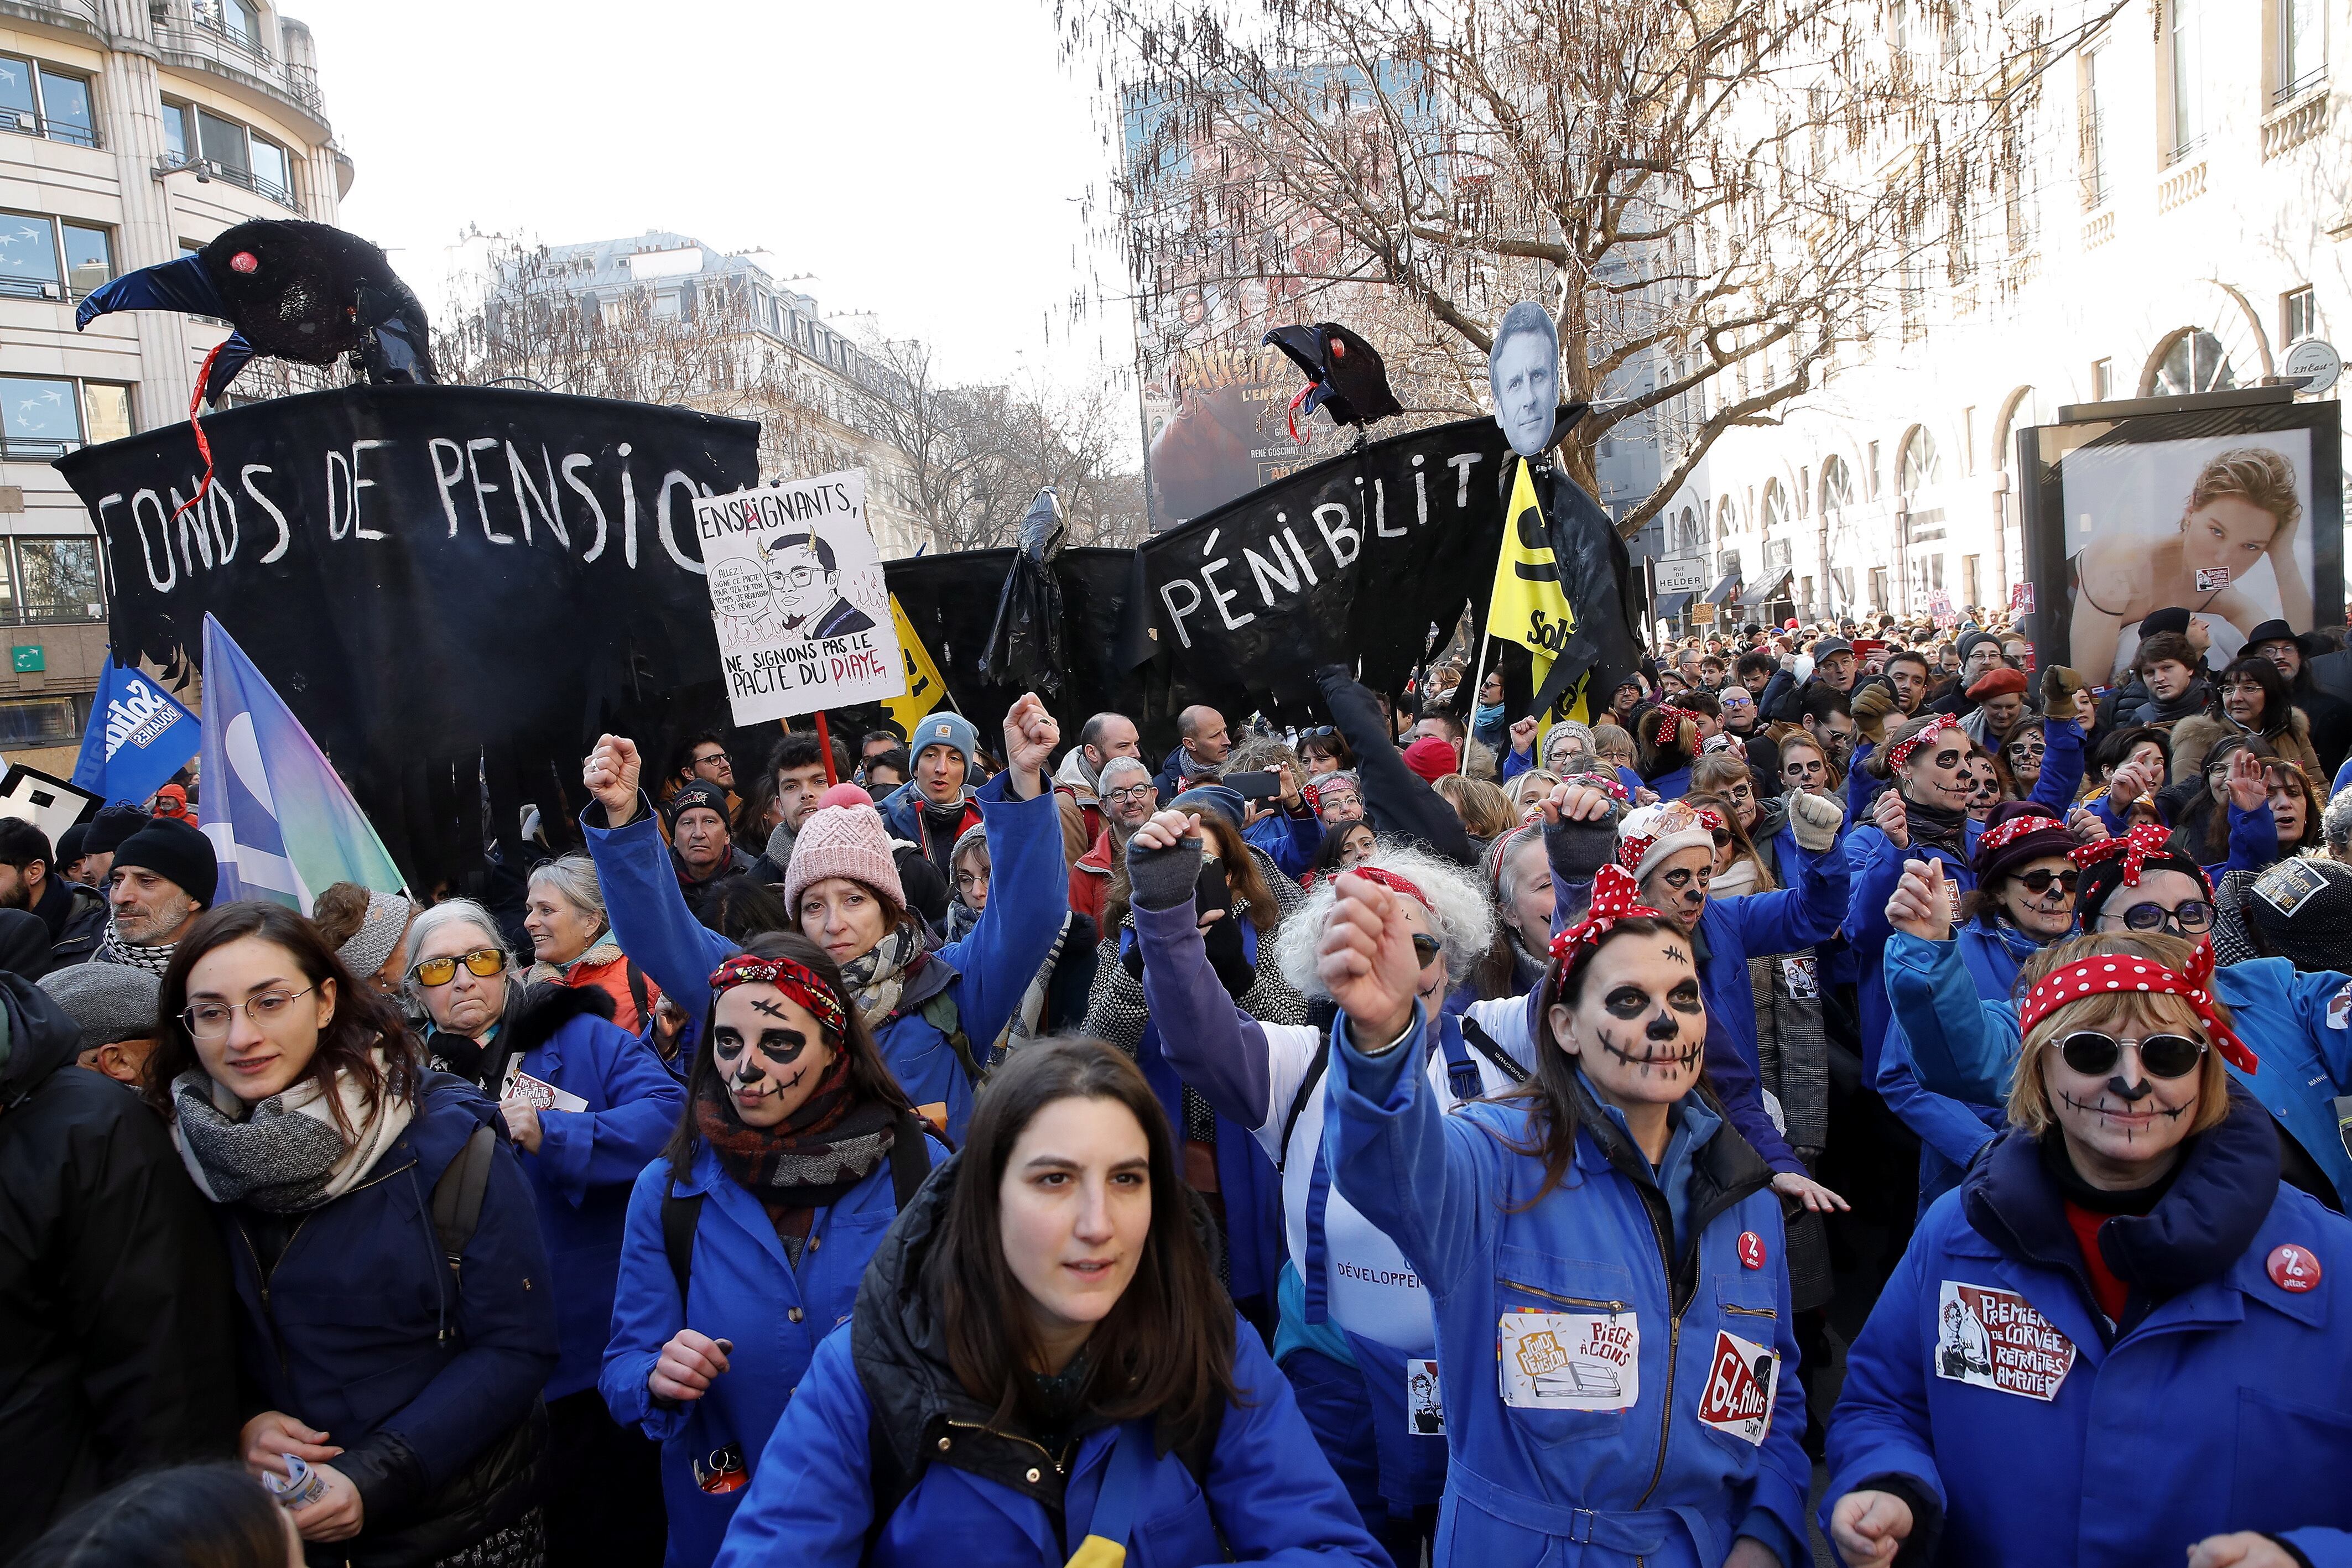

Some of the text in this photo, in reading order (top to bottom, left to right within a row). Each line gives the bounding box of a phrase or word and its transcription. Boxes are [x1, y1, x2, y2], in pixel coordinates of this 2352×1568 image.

[1251, 447, 1267, 459] RENÉ
[98, 437, 715, 597] FONDS DE PENSiO
[1659, 577, 1700, 587] HELDER
[714, 588, 729, 597] POUR
[736, 593, 745, 602] JE
[722, 604, 736, 612] TES
[725, 655, 745, 674] NE
[823, 638, 848, 657] PAS
[852, 633, 873, 650] LE
[732, 665, 794, 699] PACTE
[799, 660, 827, 686] DU
[519, 1078, 531, 1088] PAS
[1746, 1258, 1758, 1267] attac
[2283, 1279, 2307, 1288] attac
[1991, 1330, 2004, 1340] DE
[1523, 1333, 1554, 1356] FONDS
[1537, 1350, 1548, 1360] DE
[1580, 1339, 1631, 1367] À CONS
[1711, 1352, 1765, 1418] 64 ANS
